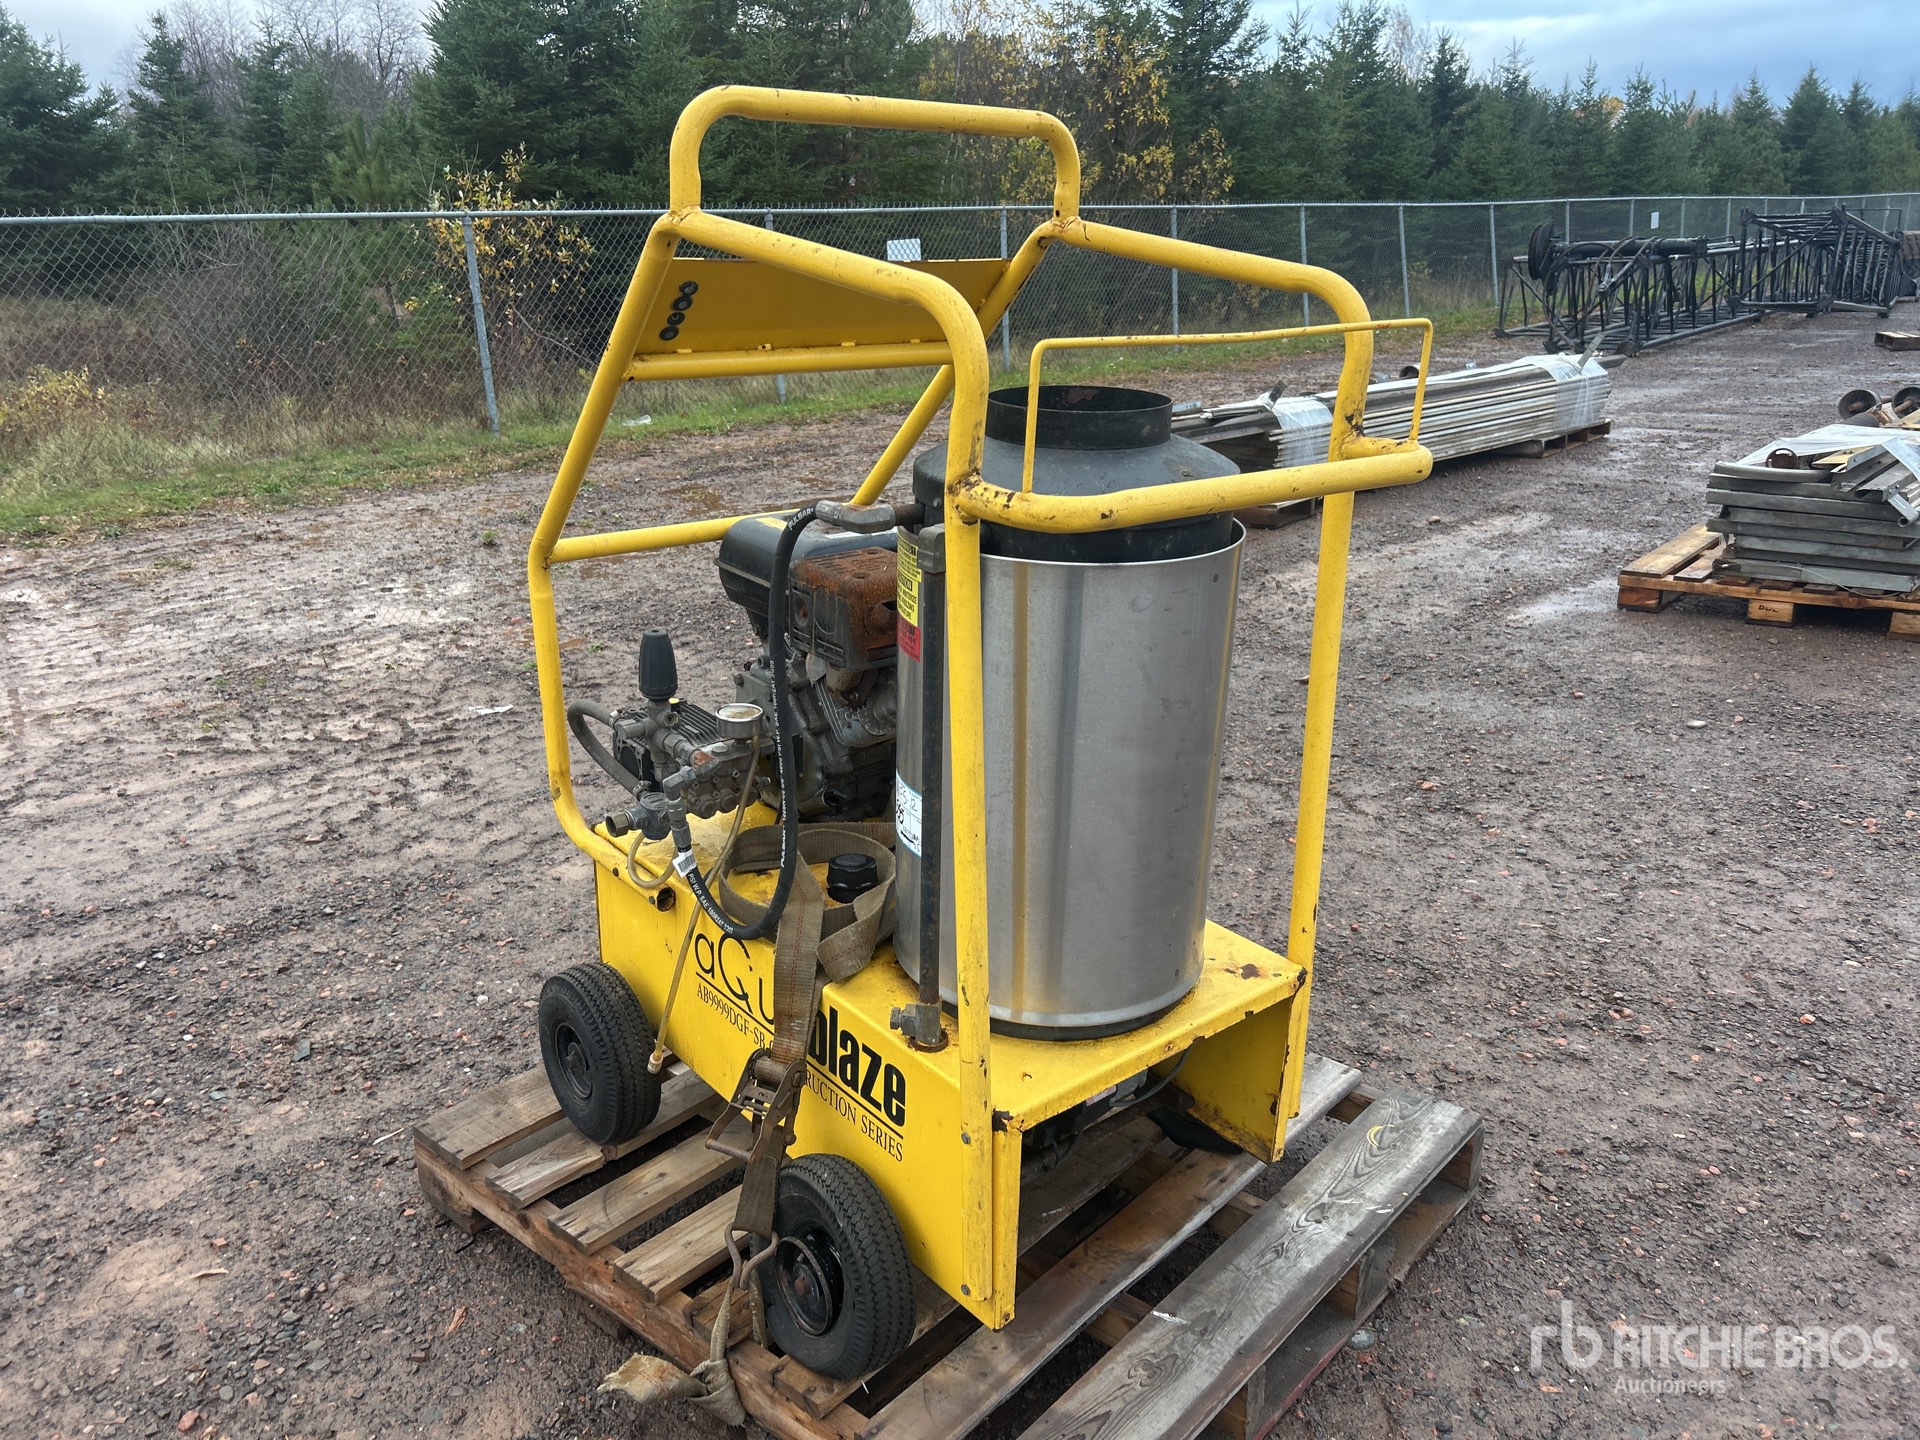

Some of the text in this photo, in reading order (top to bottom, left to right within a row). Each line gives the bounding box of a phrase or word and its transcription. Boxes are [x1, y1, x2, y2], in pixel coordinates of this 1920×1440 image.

[788, 508, 811, 530] PULSAR
[688, 873, 698, 885] PSI
[699, 895, 709, 909] SAE
[861, 1115, 903, 1162] SERIES
